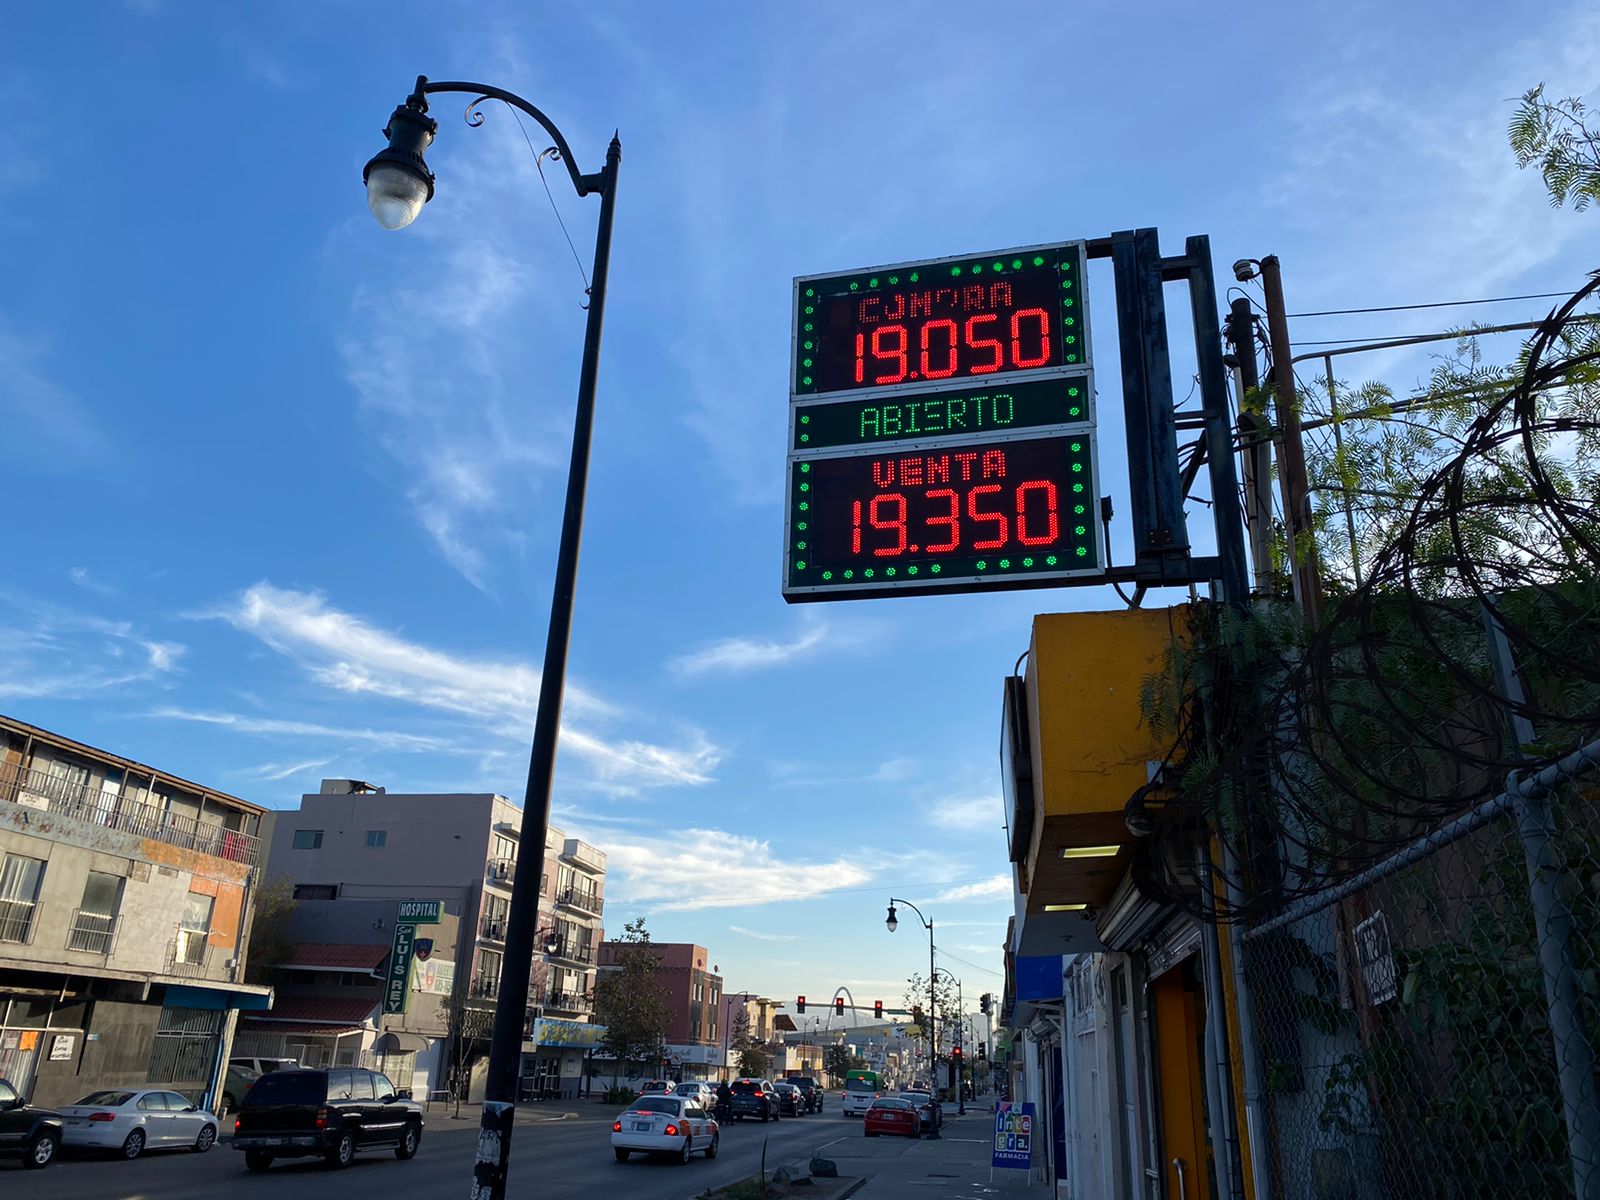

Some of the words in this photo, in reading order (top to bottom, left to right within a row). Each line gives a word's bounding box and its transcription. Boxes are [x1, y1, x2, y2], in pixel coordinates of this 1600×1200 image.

[855, 307, 1051, 385] 19.050
[860, 394, 1014, 438] ABIERTO
[872, 449, 1007, 488] VENTA
[852, 480, 1059, 557] 19.350
[400, 903, 437, 917] HOSPITAL
[394, 934, 409, 975] LUIS
[389, 980, 403, 1012] REY
[994, 1152, 1029, 1160] FARMACIA
